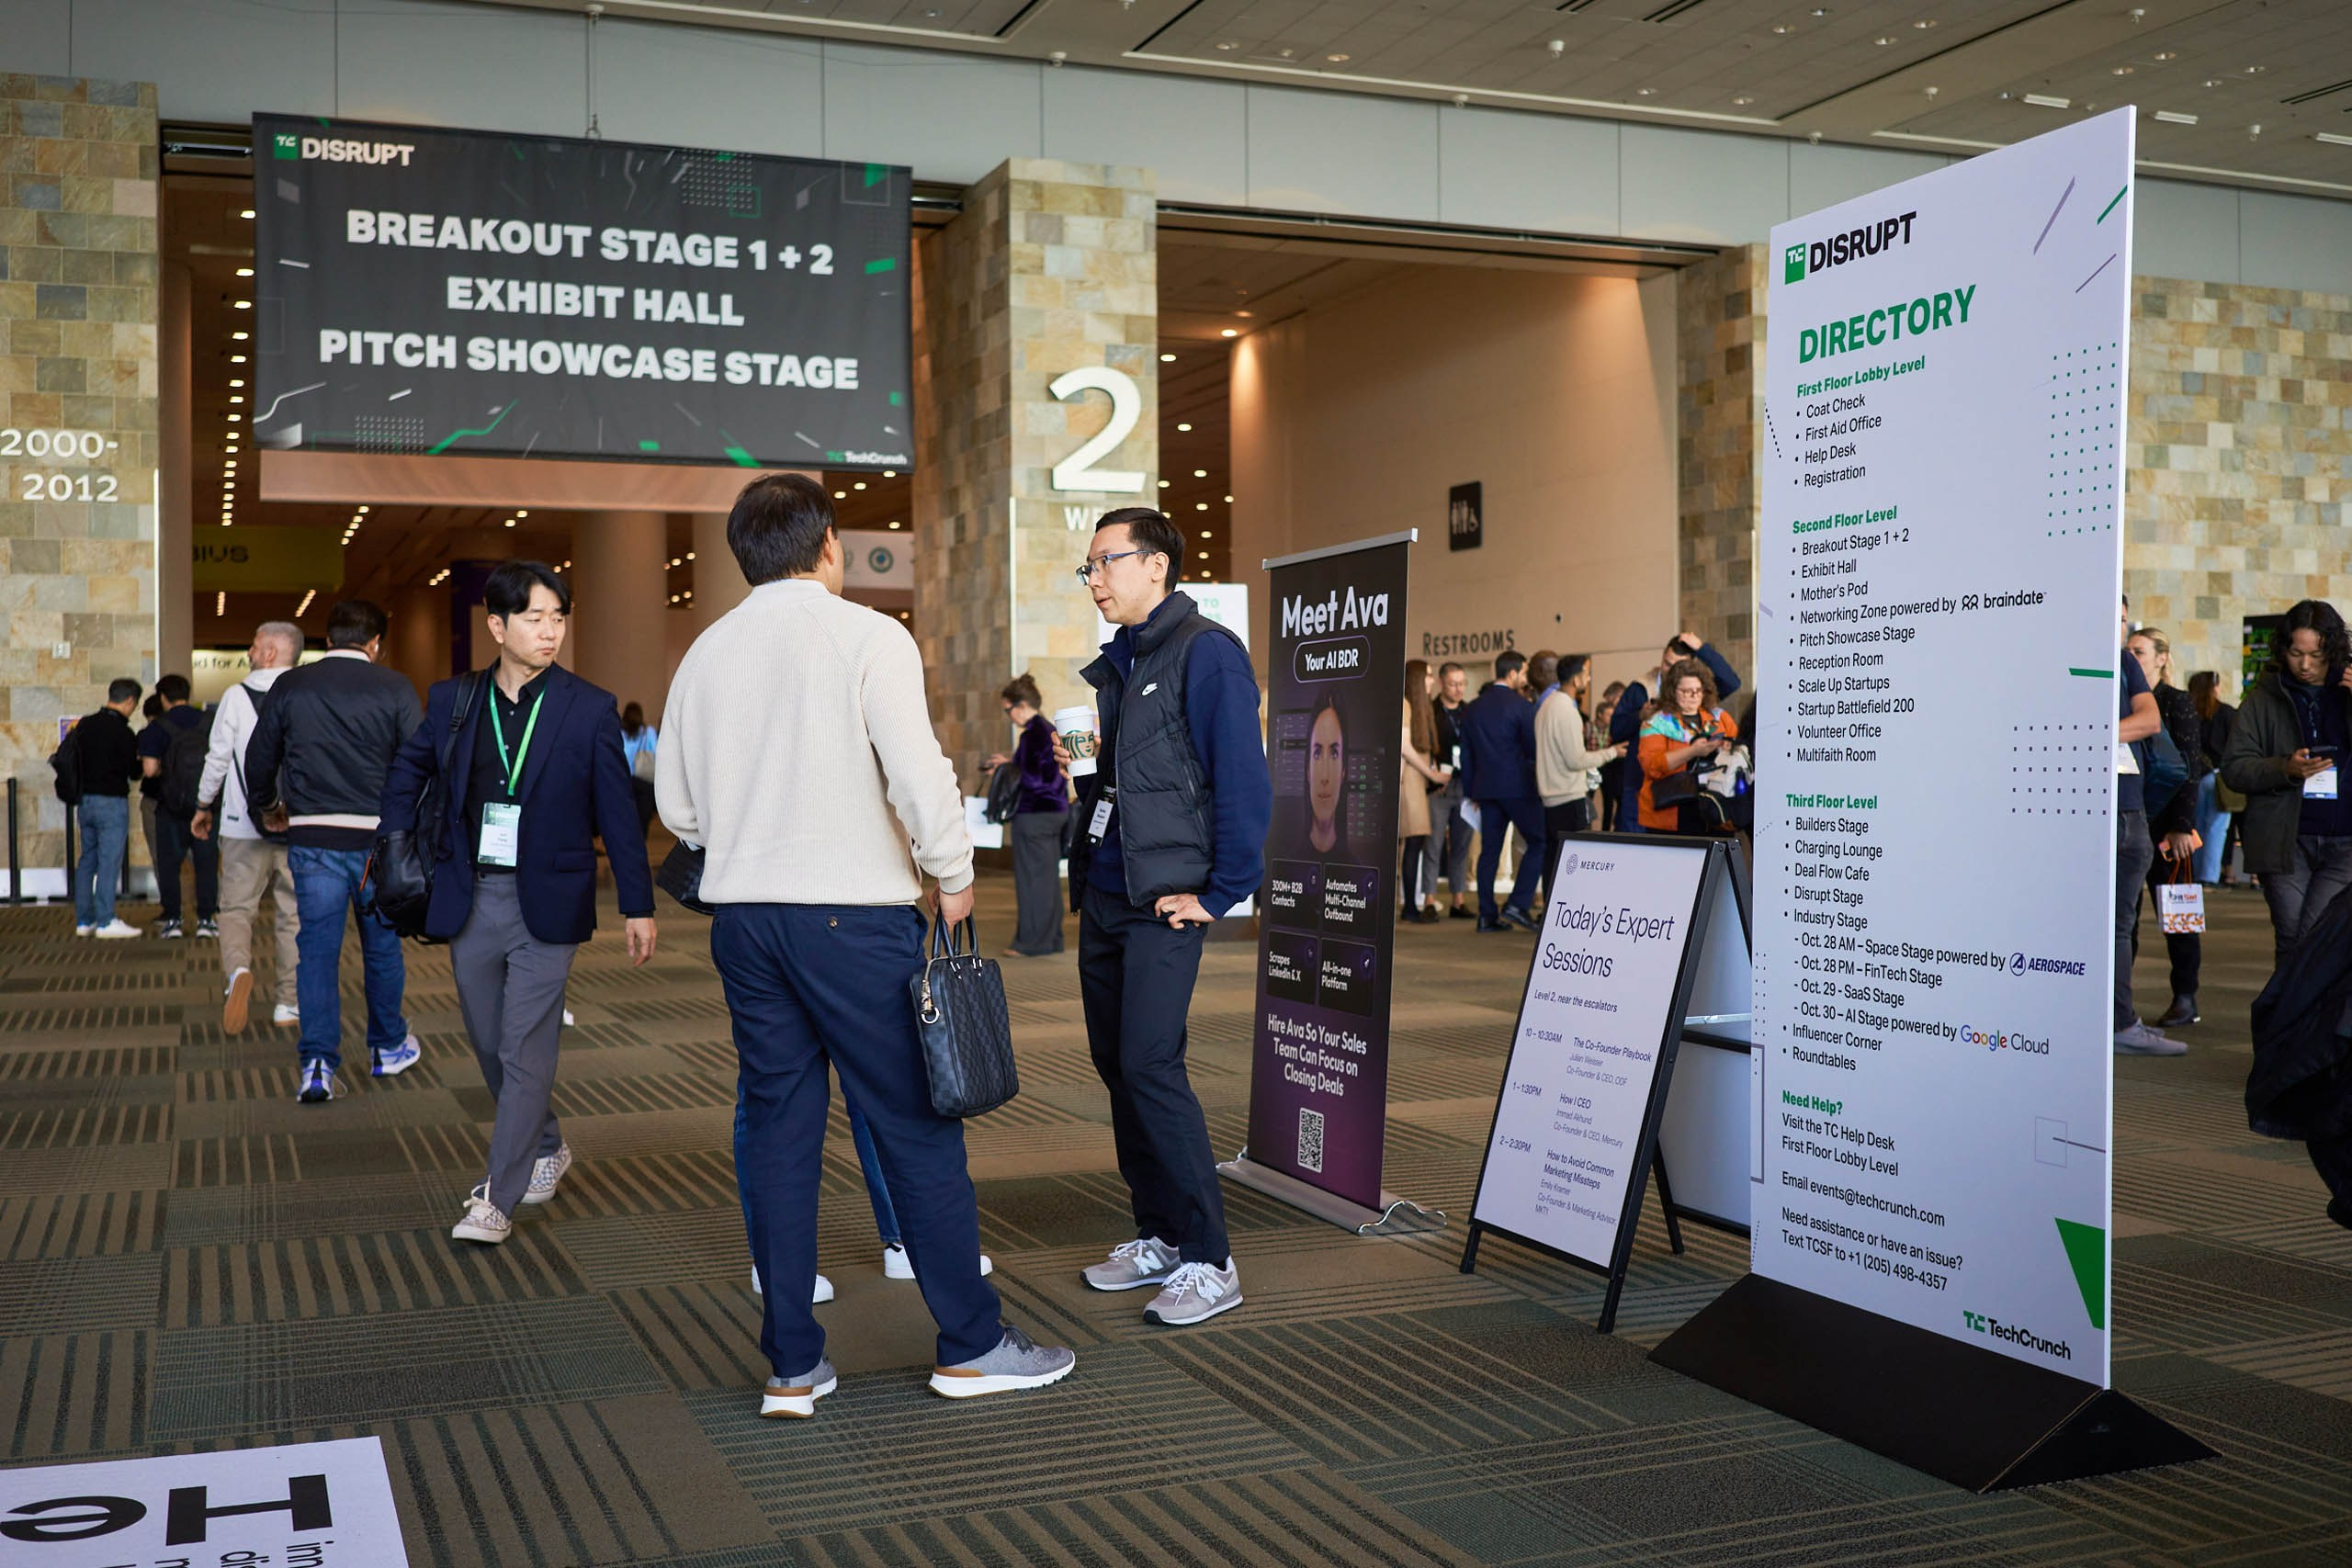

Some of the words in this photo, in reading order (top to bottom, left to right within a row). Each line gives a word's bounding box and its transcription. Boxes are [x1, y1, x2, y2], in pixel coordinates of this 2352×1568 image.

[301, 138, 414, 167] DISRUPT
[347, 209, 592, 258] BREAKOUT
[600, 227, 739, 268] STAGE
[747, 240, 767, 270] 1
[779, 245, 801, 269] +
[809, 243, 833, 275] 2
[1809, 210, 1917, 273] DISRUPT
[447, 276, 624, 319] EXHIBIT
[633, 288, 745, 326] HALL
[1800, 284, 1977, 364] DIRECTORY
[320, 329, 457, 368] PITCH
[467, 336, 718, 382] SHOWCASE
[724, 351, 859, 389] STAGE
[1797, 381, 1822, 398] First
[1824, 376, 1853, 391] Floor
[1855, 366, 1891, 385] Lobby
[1893, 355, 1925, 376] Level
[1806, 402, 1830, 418] Coat
[1832, 393, 1866, 412] Check
[1049, 367, 1147, 492] 2
[1805, 426, 1828, 441] First
[1830, 420, 1847, 436] Aid
[1849, 415, 1882, 433] Office
[0, 429, 119, 458] 2000-
[1804, 448, 1827, 464] Help
[1830, 442, 1857, 459] Desk
[22, 473, 119, 502] 2012
[1804, 466, 1866, 488] Registration
[1792, 515, 1832, 534] Second
[1835, 512, 1863, 528] Floor
[1866, 505, 1897, 524] Level
[1803, 537, 1848, 556] Breakout
[1849, 533, 1881, 549] Stage
[1883, 531, 1889, 545] 1
[1893, 533, 1899, 542] +
[1902, 528, 1909, 543] 2
[1802, 561, 1836, 579] Exhibit
[1838, 558, 1857, 574] Hall
[1801, 584, 1845, 602] Mother's
[1848, 581, 1868, 596] Pod
[1282, 590, 1338, 638] Meet
[1340, 585, 1388, 631] Ava
[1800, 605, 1858, 624] Networking
[1860, 604, 1887, 619] Zone
[1890, 598, 1939, 620] powered
[1942, 597, 1956, 615] by
[1984, 590, 2043, 608] braindate
[1800, 632, 1825, 647] Pitch
[1826, 630, 1881, 646] Showcase
[1883, 626, 1916, 643] Stage
[1305, 653, 1325, 671] Your
[1326, 650, 1337, 670] AI
[1338, 648, 1359, 668] BDR
[1799, 654, 1850, 671] Reception
[1852, 653, 1883, 667] Room
[1798, 678, 1826, 693] Scale
[1828, 678, 1842, 694] Up
[1844, 676, 1890, 693] Startups
[1798, 702, 1835, 717] Startup
[1838, 699, 1891, 715] Battlefield
[1893, 698, 1915, 713] 200
[1797, 725, 1847, 739] Volunteer
[1849, 724, 1882, 738] Office
[1797, 748, 1843, 761] Multifaith
[1846, 748, 1876, 761] Room
[1786, 794, 1814, 807] Third
[1816, 795, 1845, 808] Floor
[1847, 795, 1878, 809] Level
[1795, 817, 1836, 831] Builders
[1838, 818, 1869, 836] Stage
[1795, 840, 1840, 858] Charging
[1843, 841, 1883, 861] Lounge
[1579, 861, 1615, 872] MERCURY
[1795, 863, 1816, 877] Deal
[1819, 864, 1843, 879] Flow
[1845, 866, 1870, 881] Cafe
[1325, 878, 1357, 893] Automates
[1794, 886, 1831, 904] Disrupt
[1833, 888, 1863, 908] Stage
[1272, 894, 1295, 908] Contacts
[1325, 893, 1366, 909] Multi-Channel
[1324, 908, 1353, 922] Outbound
[1555, 901, 1613, 938] Today’s
[1616, 908, 1675, 943] Expert
[1794, 908, 1836, 928] Industry
[1838, 912, 1868, 931] Stage
[1269, 951, 1290, 967] Scrapes
[1543, 942, 1613, 977] Sessions
[1802, 932, 1822, 950] Oct.
[1824, 934, 1837, 950] 28
[1838, 936, 1856, 952] AM
[1865, 939, 1899, 958] Space
[1901, 942, 1934, 962] Stage
[1936, 948, 1988, 968] powered
[1990, 952, 2006, 971] by
[2029, 957, 2086, 976] AEROSPACE
[1321, 975, 1348, 991] Platform
[1534, 988, 1550, 1000] Level
[1557, 996, 1572, 1006] near
[1572, 997, 1583, 1007] the
[1584, 1000, 1618, 1013] escalators
[1268, 1013, 1286, 1034] Hire
[1286, 1018, 1304, 1039] Ava
[1305, 1022, 1317, 1042] So
[1318, 1025, 1340, 1048] Your
[1341, 1031, 1367, 1055] Sales
[1792, 1023, 1843, 1045] Influencer
[1845, 1032, 1882, 1052] Corner
[1273, 1037, 1298, 1061] Team
[1299, 1043, 1317, 1066] Can
[1318, 1050, 1345, 1073] Focus
[1346, 1060, 1358, 1077] on
[1573, 1037, 1584, 1048] The
[1585, 1040, 1622, 1056] Co-Founder
[1622, 1047, 1653, 1063] Playbook
[1792, 1046, 1857, 1071] Roundtables
[1284, 1063, 1317, 1093] Closing
[1317, 1072, 1344, 1097] Deals
[1559, 1093, 1573, 1104] How
[1577, 1097, 1591, 1110] CEO
[1546, 1149, 1560, 1162] How
[1562, 1154, 1567, 1164] to
[1568, 1156, 1586, 1169] Avoid
[1586, 1160, 1614, 1178] Common
[1543, 1164, 1572, 1183] Marketing
[1573, 1172, 1600, 1190] Missteps
[1782, 1171, 1808, 1191] Email
[1810, 1179, 1945, 1227] events@techcrunch.com
[1782, 1229, 1804, 1249] Text
[1806, 1236, 1833, 1256] TCSF
[1836, 1246, 1846, 1261] to
[1848, 1250, 1860, 1265] +1
[1863, 1253, 1891, 1277] (205)
[1893, 1264, 1947, 1292] 498-4357
[1963, 1310, 1985, 1333] TC
[1987, 1317, 2071, 1360] TechCrunch
